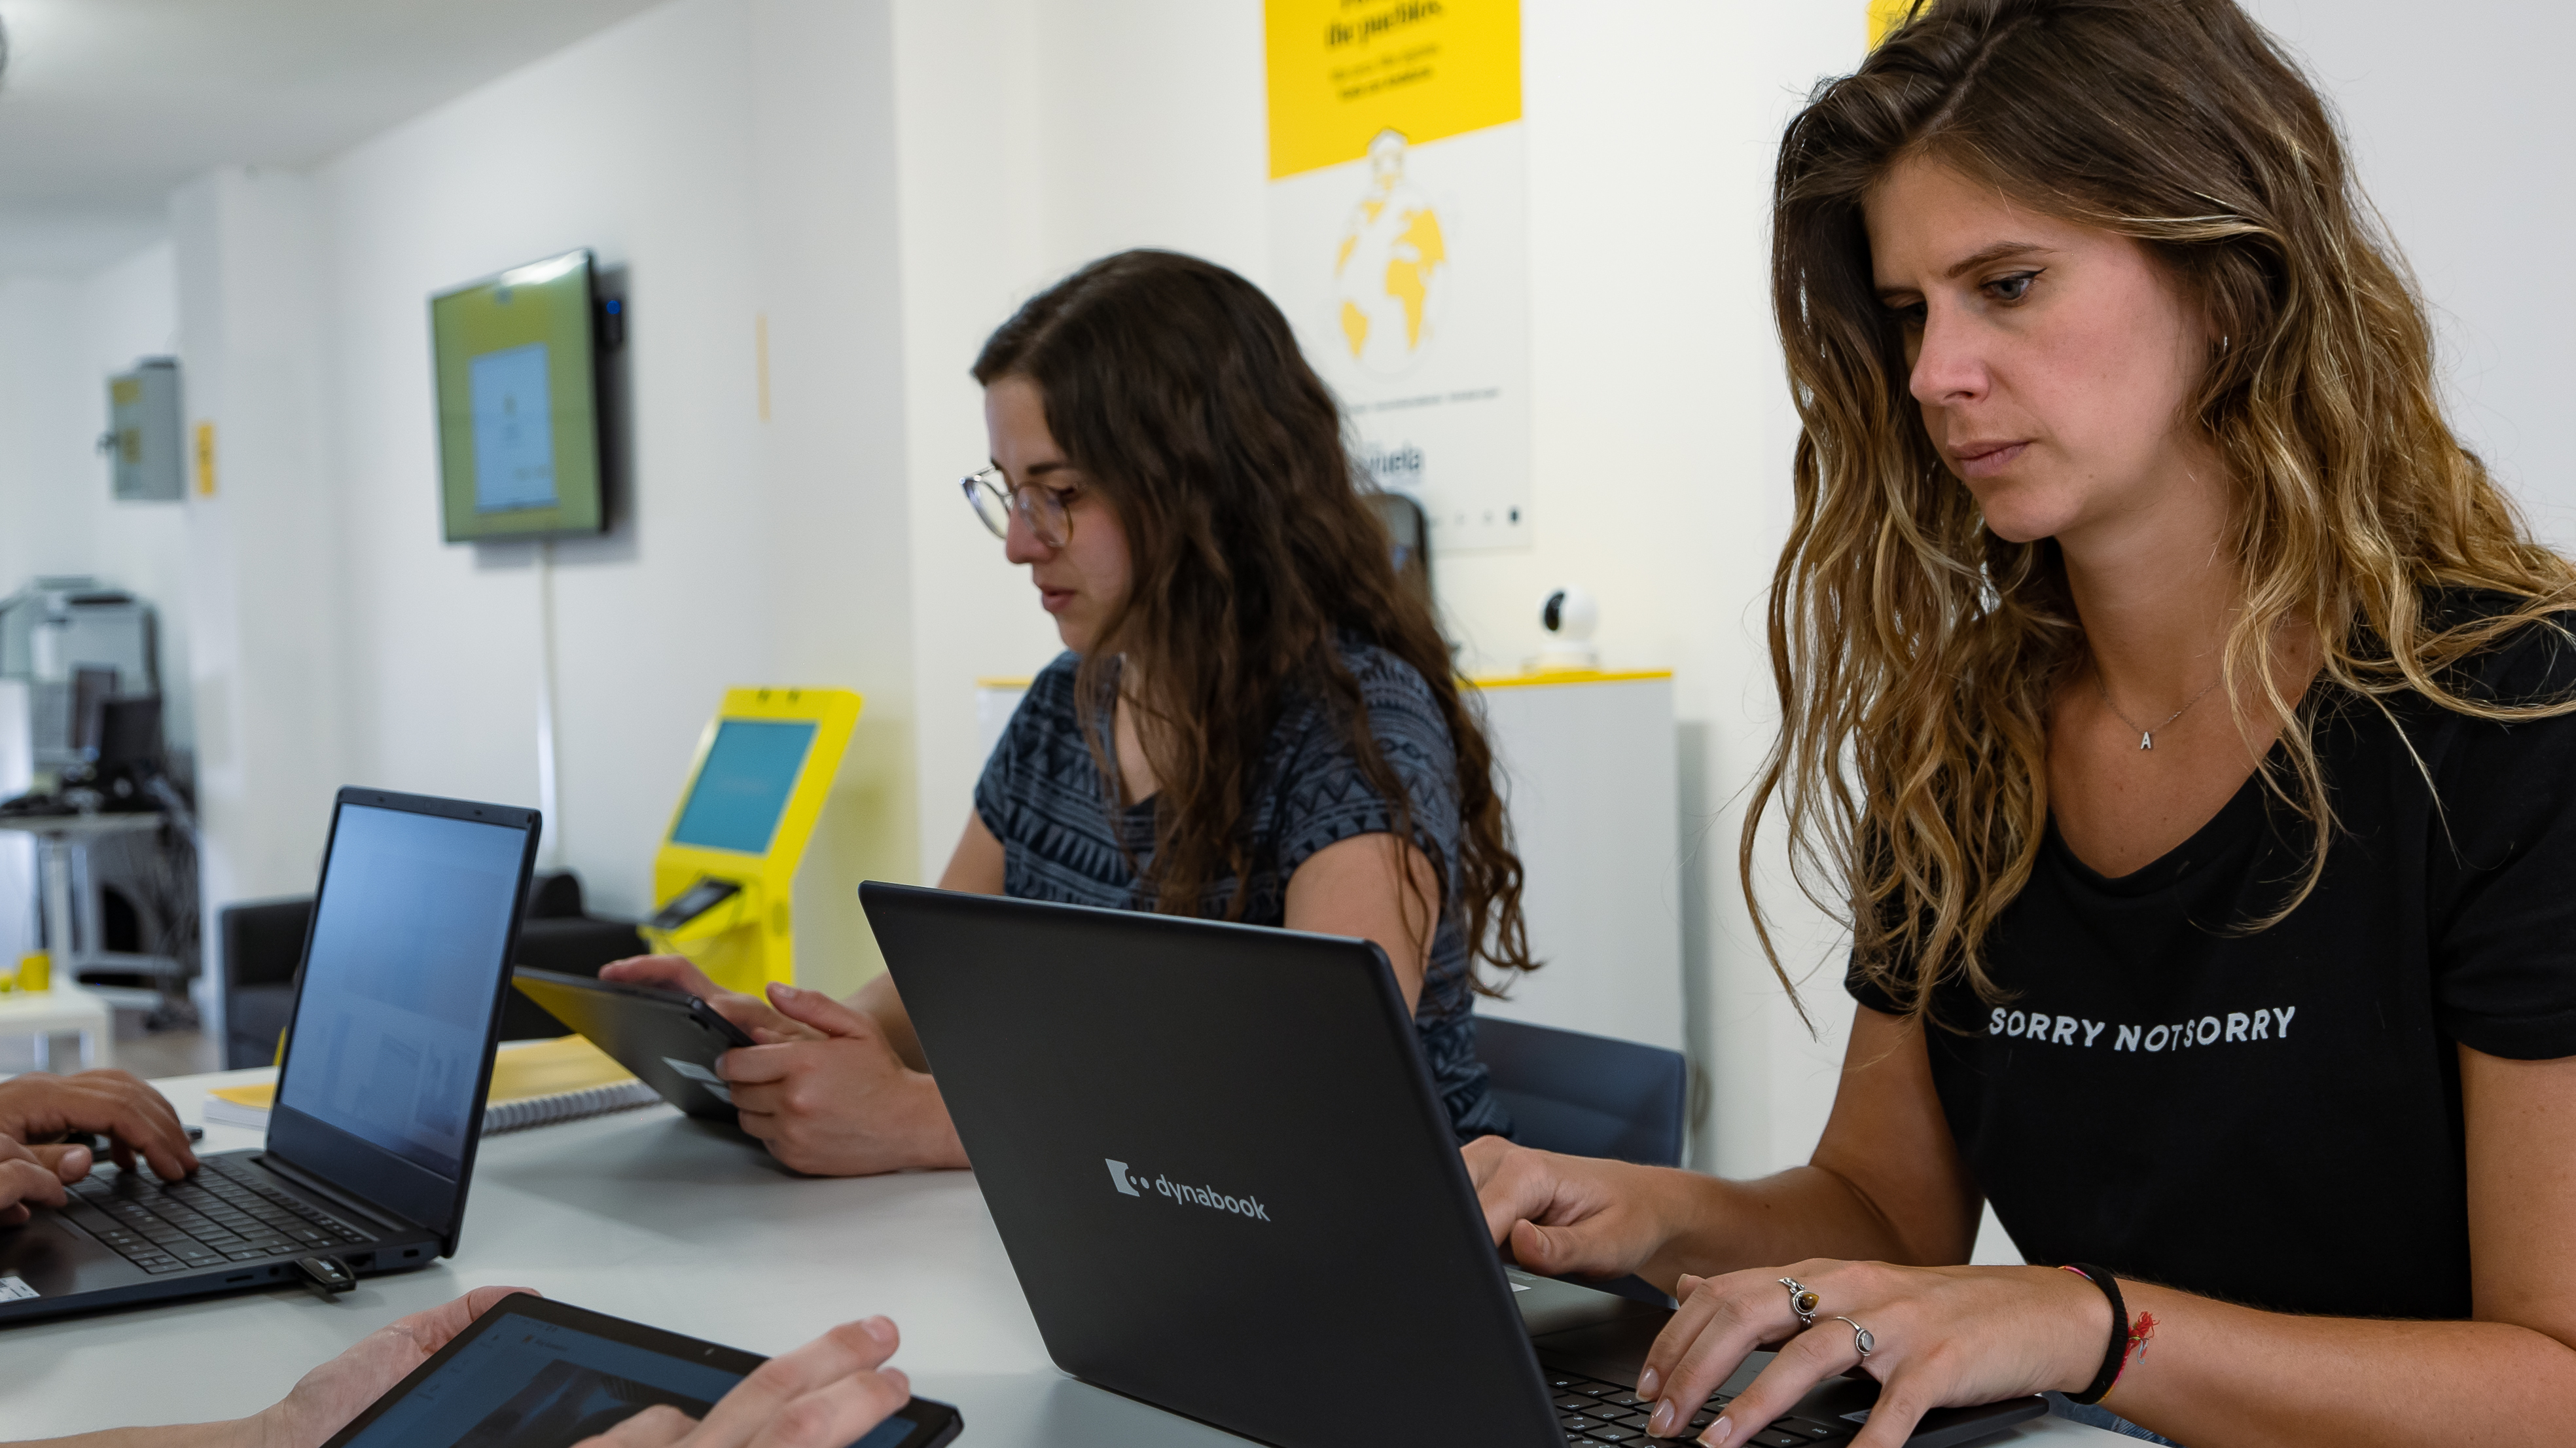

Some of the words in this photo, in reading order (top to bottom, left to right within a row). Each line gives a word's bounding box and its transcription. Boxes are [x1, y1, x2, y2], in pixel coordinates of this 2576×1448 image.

[2140, 731, 2151, 750] A
[1989, 1007, 2105, 1047] SORRY
[1155, 1174, 1271, 1222] dynabook
